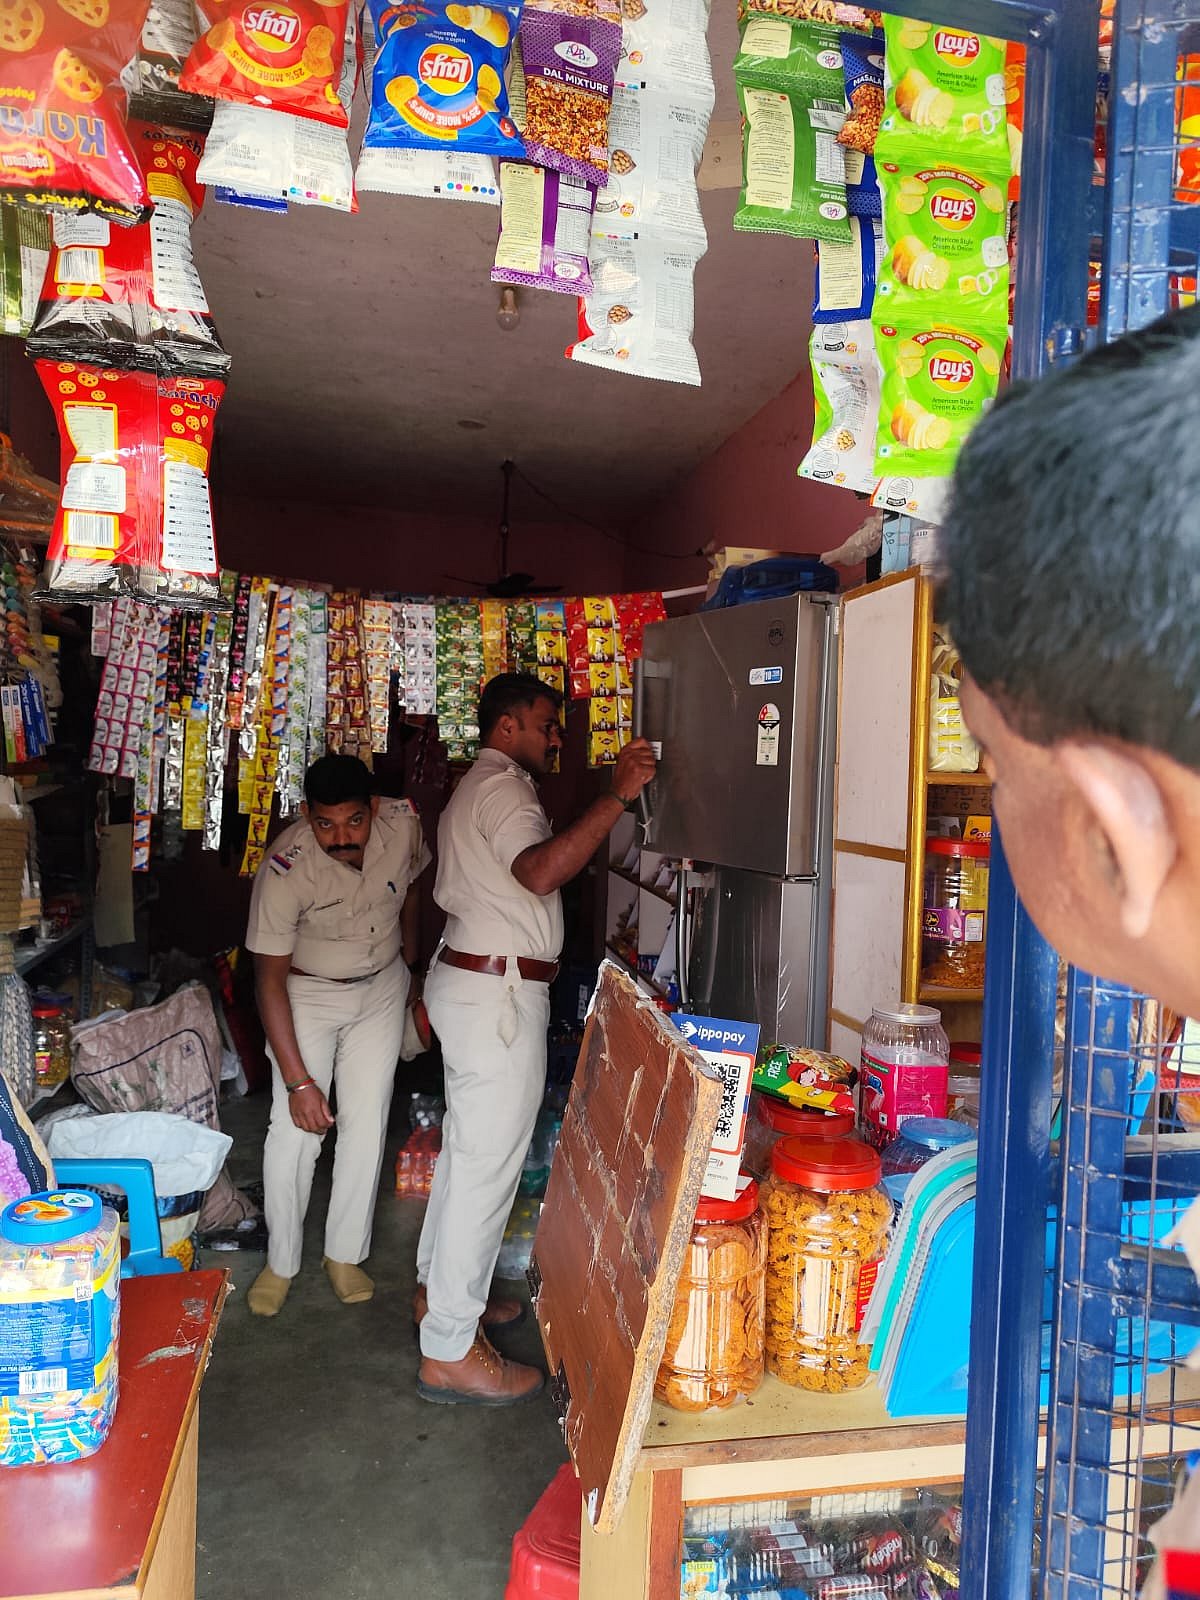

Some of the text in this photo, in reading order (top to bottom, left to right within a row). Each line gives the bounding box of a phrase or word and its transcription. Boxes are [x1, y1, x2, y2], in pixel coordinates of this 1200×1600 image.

[245, 9, 297, 43] Lay's
[937, 32, 978, 58] Lay's
[257, 69, 284, 83] MORE
[421, 53, 469, 83] Lay's
[853, 74, 882, 87] MASALA
[543, 67, 564, 80] DAL
[565, 73, 609, 95] MIXTURE
[435, 114, 462, 127] MORE
[461, 104, 482, 122] 25%
[934, 196, 974, 221] Lay's
[932, 358, 972, 383] Lay's
[767, 1060, 783, 1079] FREE
